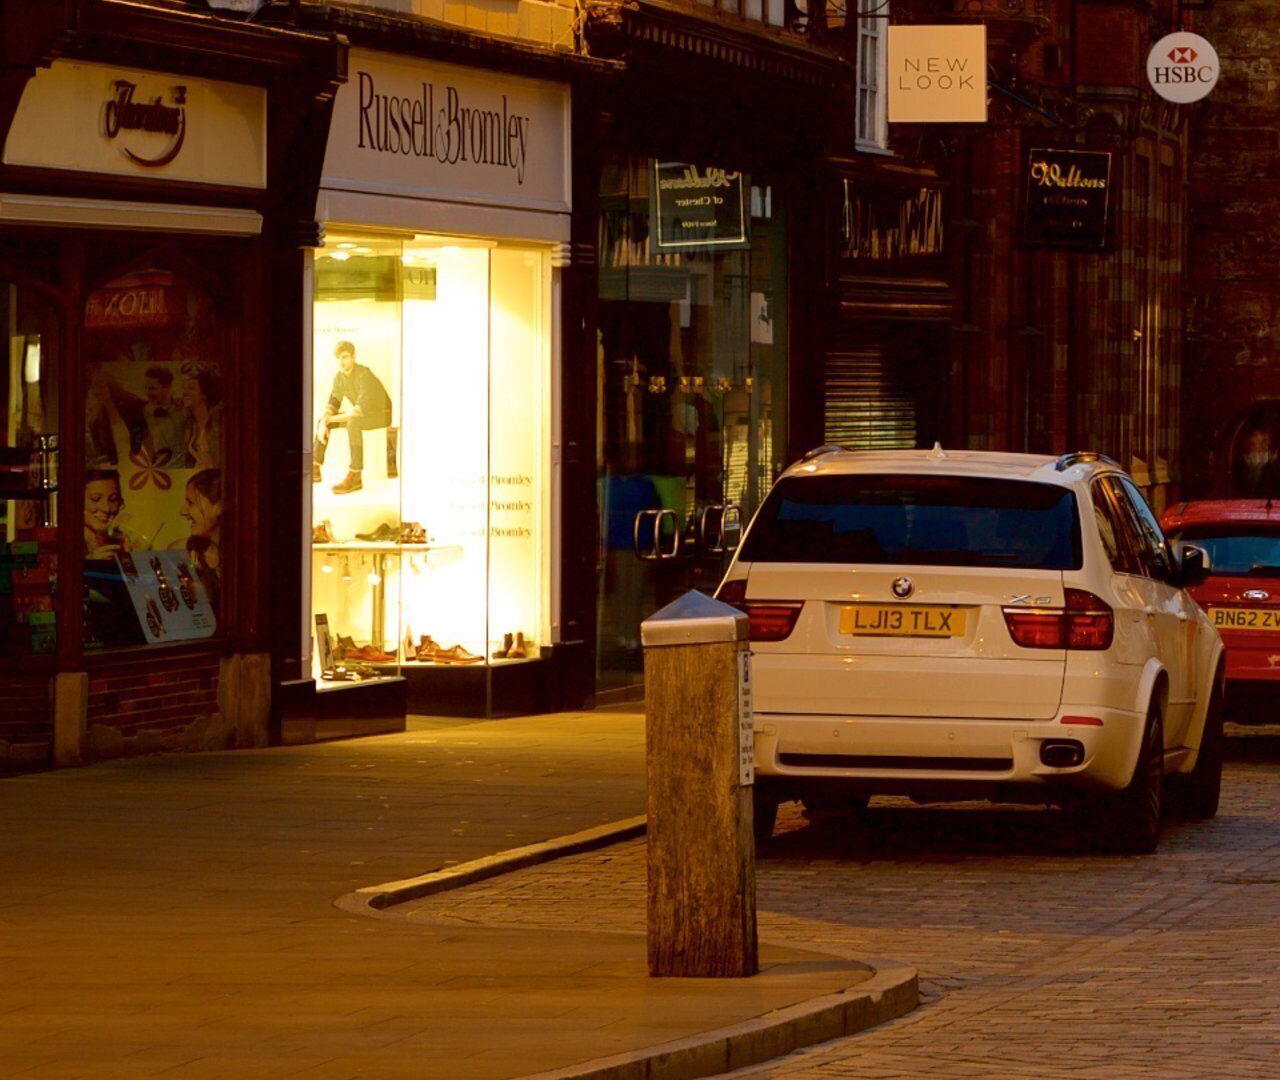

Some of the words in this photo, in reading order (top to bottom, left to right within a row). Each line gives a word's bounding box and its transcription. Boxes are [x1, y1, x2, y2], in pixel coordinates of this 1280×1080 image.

[904, 58, 968, 72] NEW
[899, 74, 974, 90] LOOK
[1154, 66, 1212, 84] HSBC
[1031, 161, 1106, 188] Waltons
[854, 610, 903, 629] LJ13
[911, 611, 952, 631] TLX
[1215, 611, 1257, 626] BN62
